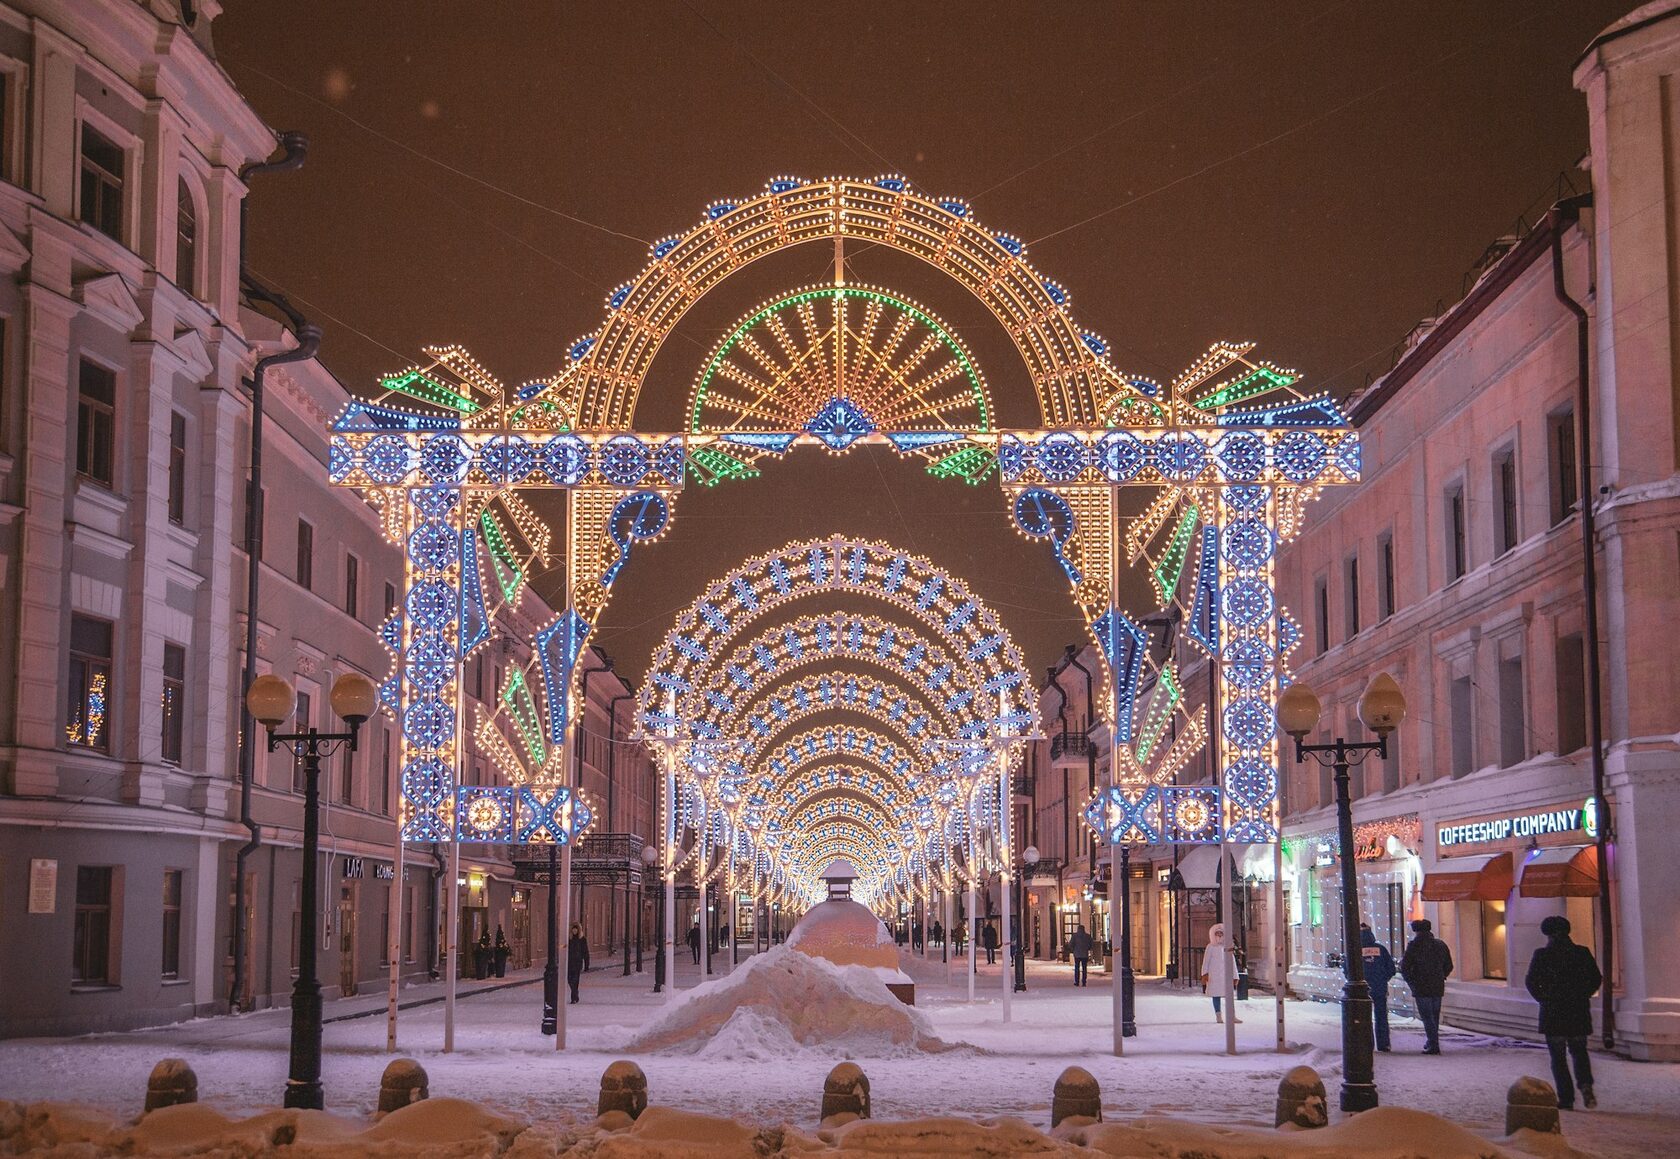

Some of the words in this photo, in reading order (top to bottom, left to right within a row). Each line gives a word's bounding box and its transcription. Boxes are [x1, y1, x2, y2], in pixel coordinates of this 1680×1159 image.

[1439, 819, 1510, 846] COFFEESHOP
[1513, 809, 1578, 837] COMPANY
[376, 864, 394, 880] LOUNG
